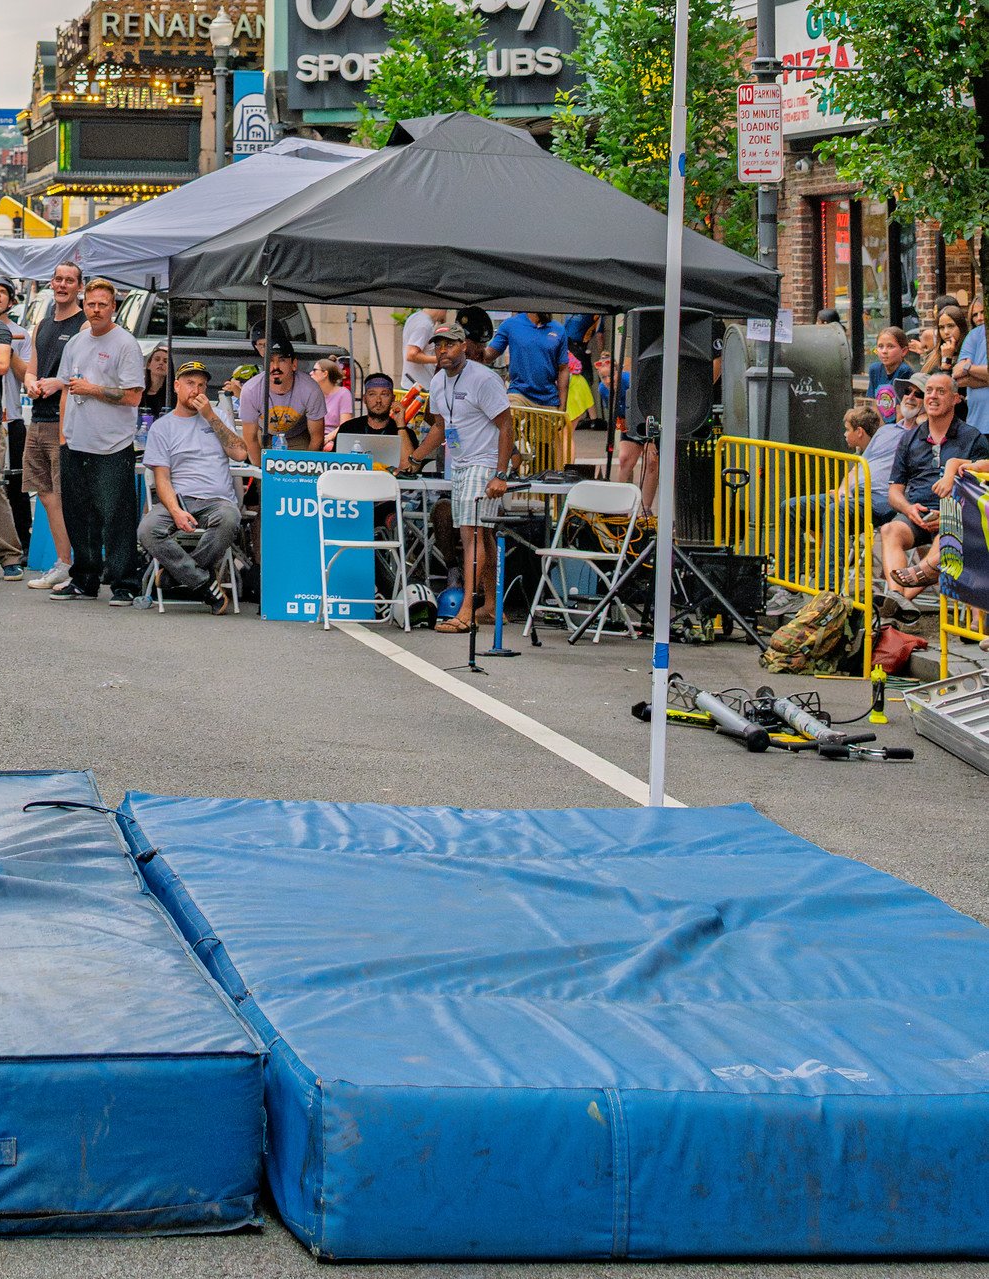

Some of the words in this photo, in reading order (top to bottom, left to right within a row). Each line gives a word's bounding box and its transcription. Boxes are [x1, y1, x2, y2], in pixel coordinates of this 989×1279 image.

[101, 12, 265, 39] RENAISAN
[296, 52, 385, 82] SPOR
[477, 47, 563, 77] UBS
[782, 44, 850, 85] PIZZA
[739, 88, 753, 102] NO
[754, 89, 780, 99] PARKING
[740, 110, 750, 119] 30
[752, 109, 780, 119] MINUTE
[740, 122, 779, 132] LOADING
[748, 135, 772, 144] ZONE
[741, 148, 747, 158] 8
[764, 148, 770, 158] 6
[266, 458, 368, 475] POGOPALOOZA
[275, 497, 361, 519] JUDGES
